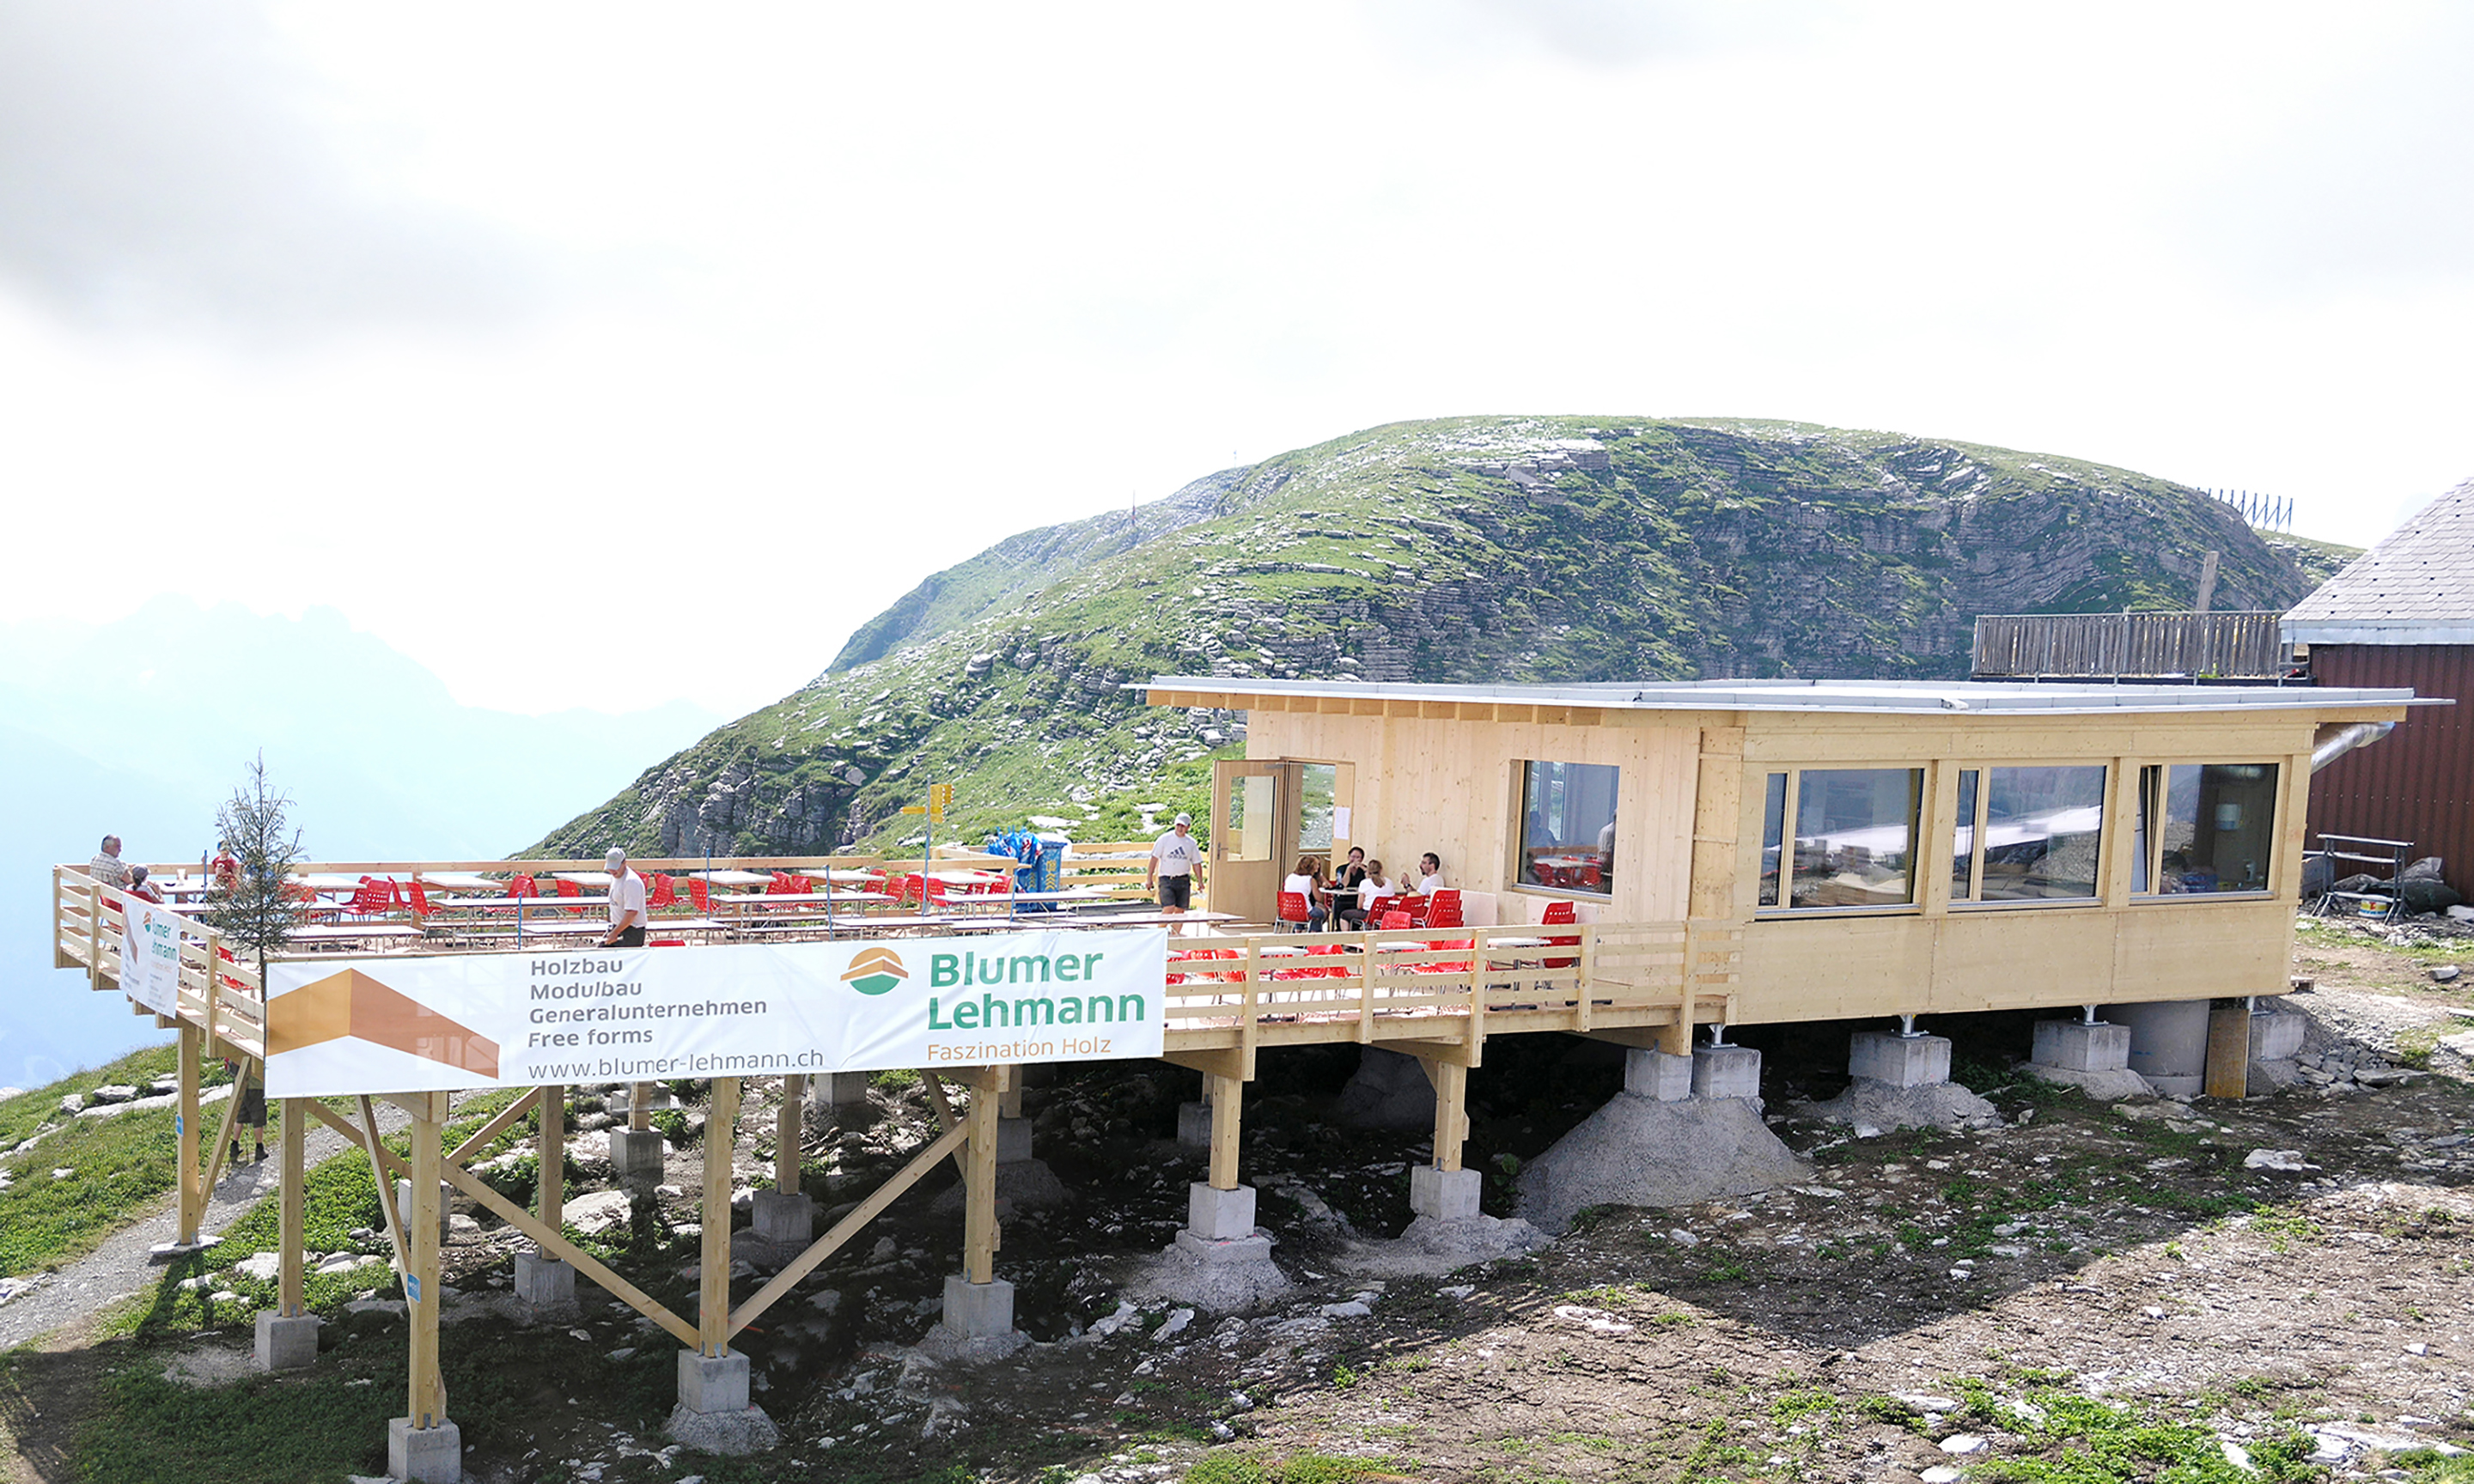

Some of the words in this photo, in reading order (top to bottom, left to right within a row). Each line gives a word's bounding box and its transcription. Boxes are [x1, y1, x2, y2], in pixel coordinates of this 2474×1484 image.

[531, 958, 624, 976] Holzbau
[930, 951, 1104, 988] Blumer
[530, 981, 643, 1000] Modulbau
[529, 1000, 768, 1025] Generalunternehmen
[927, 992, 1145, 1031] Lehmann
[528, 1031, 580, 1049] Free
[588, 1028, 654, 1046] forms
[928, 1040, 1054, 1061] Faszination
[1062, 1036, 1112, 1055] Holz
[527, 1049, 825, 1080] www.blumer-lehmann.ch
